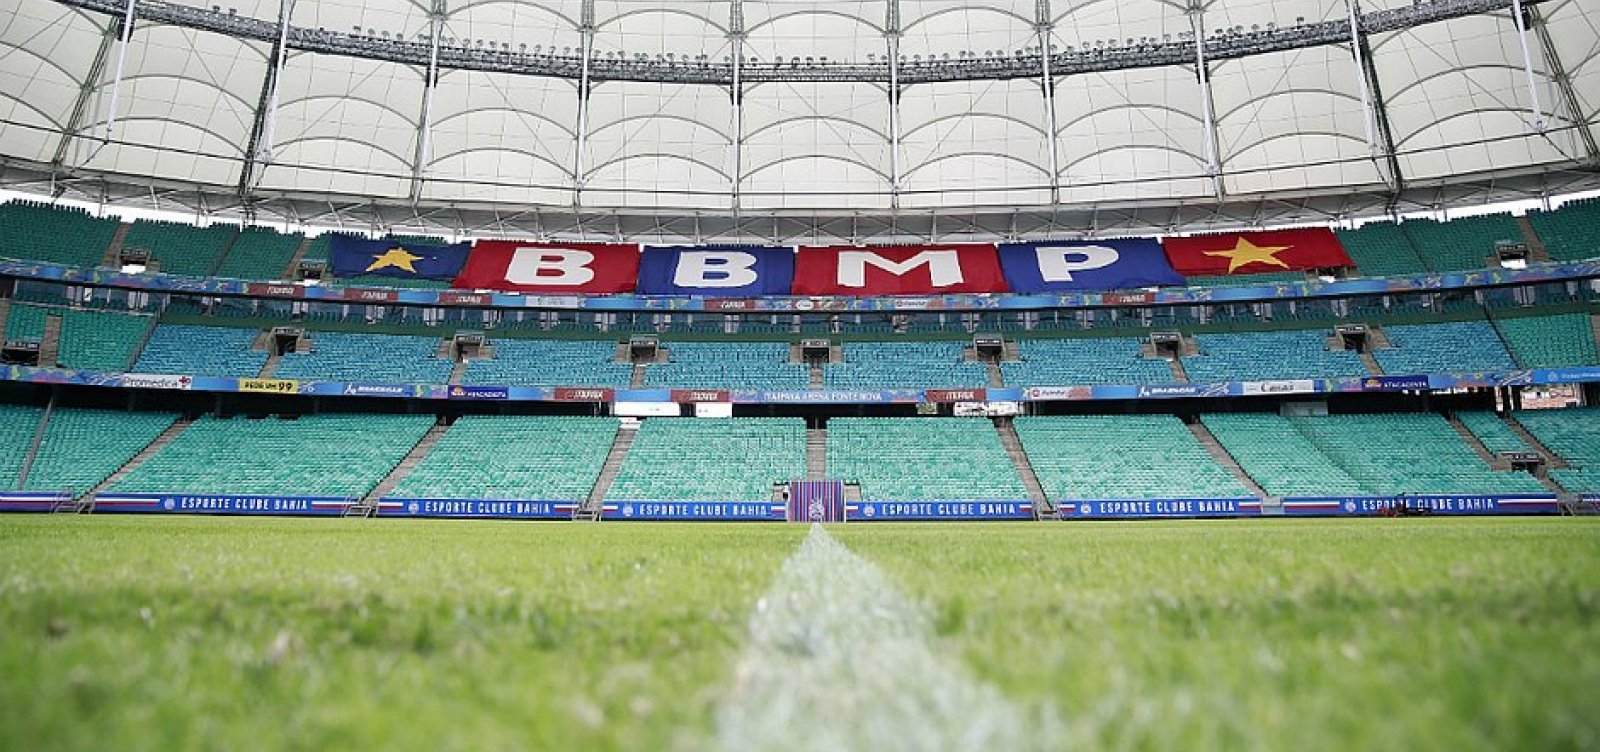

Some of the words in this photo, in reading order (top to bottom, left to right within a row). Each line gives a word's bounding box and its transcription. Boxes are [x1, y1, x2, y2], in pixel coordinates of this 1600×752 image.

[504, 247, 595, 286] B
[674, 251, 757, 287] B
[837, 250, 964, 287] M
[1035, 246, 1119, 281] P
[181, 497, 229, 509] ESPORTE
[235, 498, 269, 510] CLUBE
[274, 499, 307, 510] BAHIA
[424, 501, 473, 513] ESPORTE
[477, 502, 512, 514] CLUBE
[516, 503, 549, 514] BAHIA
[882, 504, 932, 515] ESPORTE
[938, 504, 974, 515] CLUBE
[980, 504, 1016, 515] BAHIA
[1101, 501, 1150, 514] ESPORTE
[1156, 501, 1192, 512] CLUBE
[1199, 501, 1235, 512] BAHIA
[1417, 499, 1452, 511] CLUBE
[1458, 498, 1493, 510] BAHIA
[639, 505, 688, 515] ESPORTE
[693, 505, 727, 516] CLUBE
[733, 505, 767, 516] BAHIA
